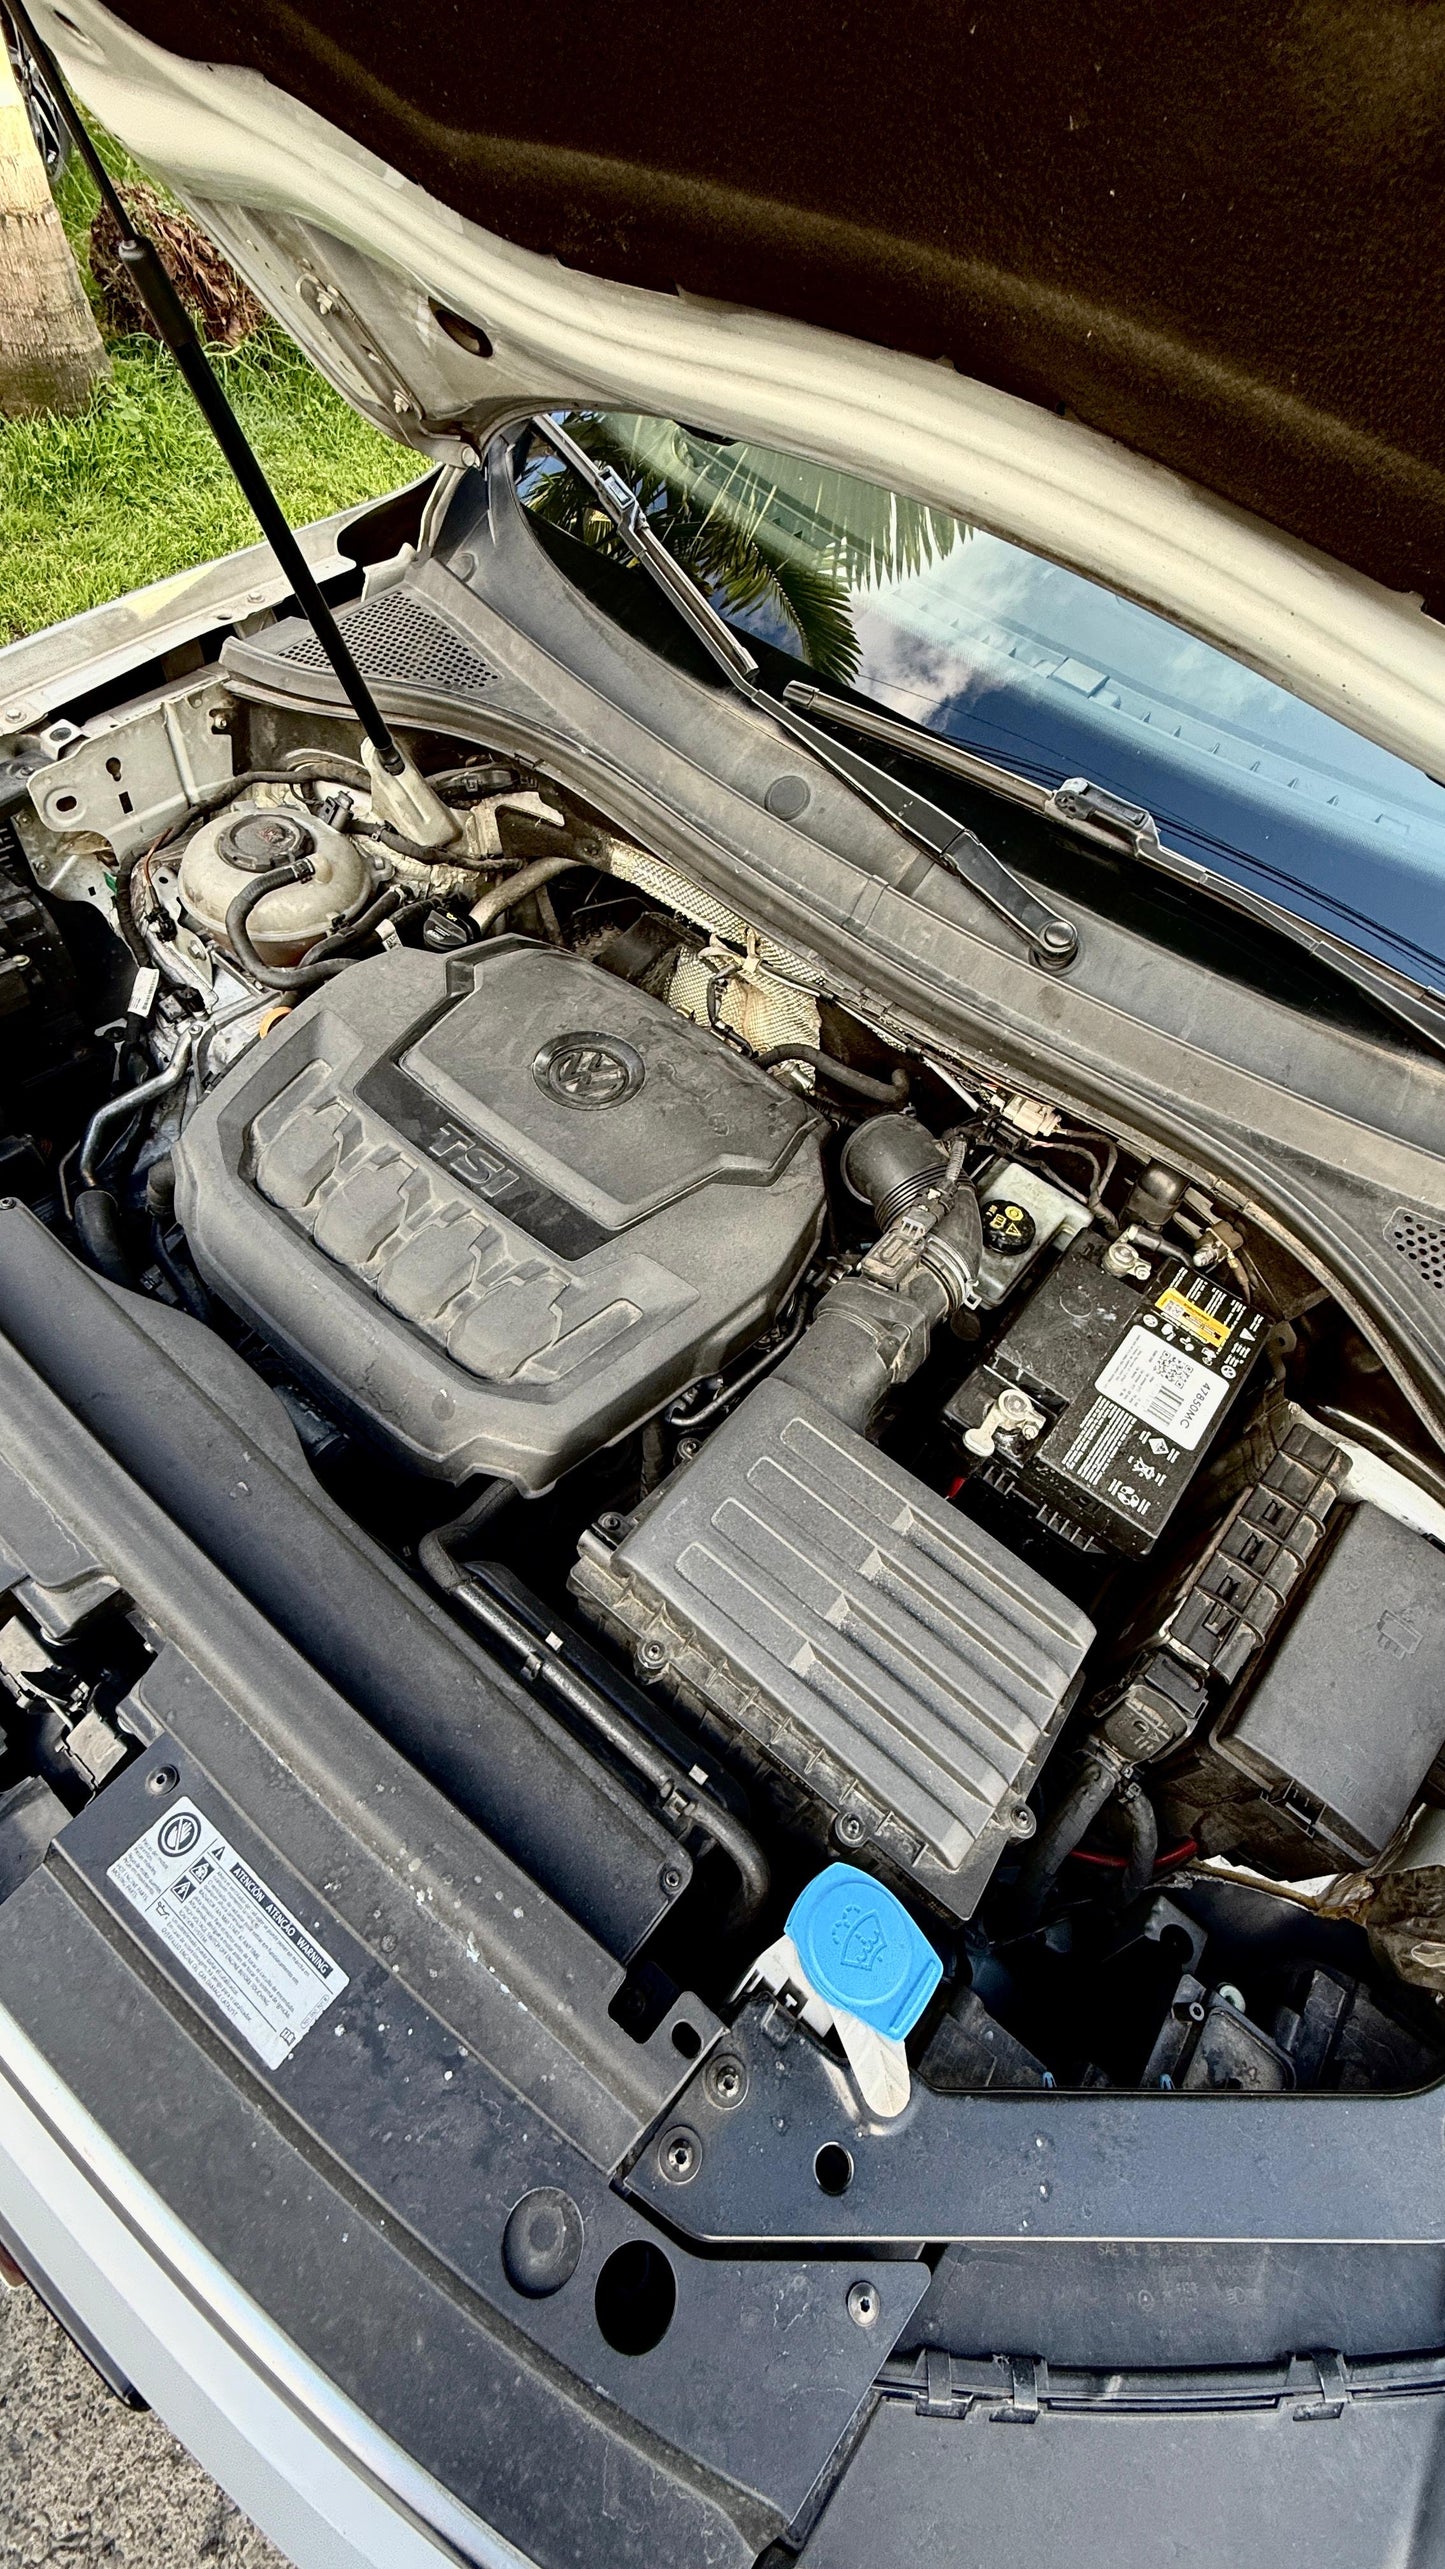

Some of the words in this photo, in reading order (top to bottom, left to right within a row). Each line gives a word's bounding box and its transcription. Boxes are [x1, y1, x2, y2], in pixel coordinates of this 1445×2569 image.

[428, 1122, 520, 1198] TSI
[1179, 1381, 1212, 1430] 47850MC
[232, 1864, 267, 1903] ATENCIÓN
[263, 1900, 298, 1939] ATENÇÃO
[295, 1935, 329, 1974] WARNING
